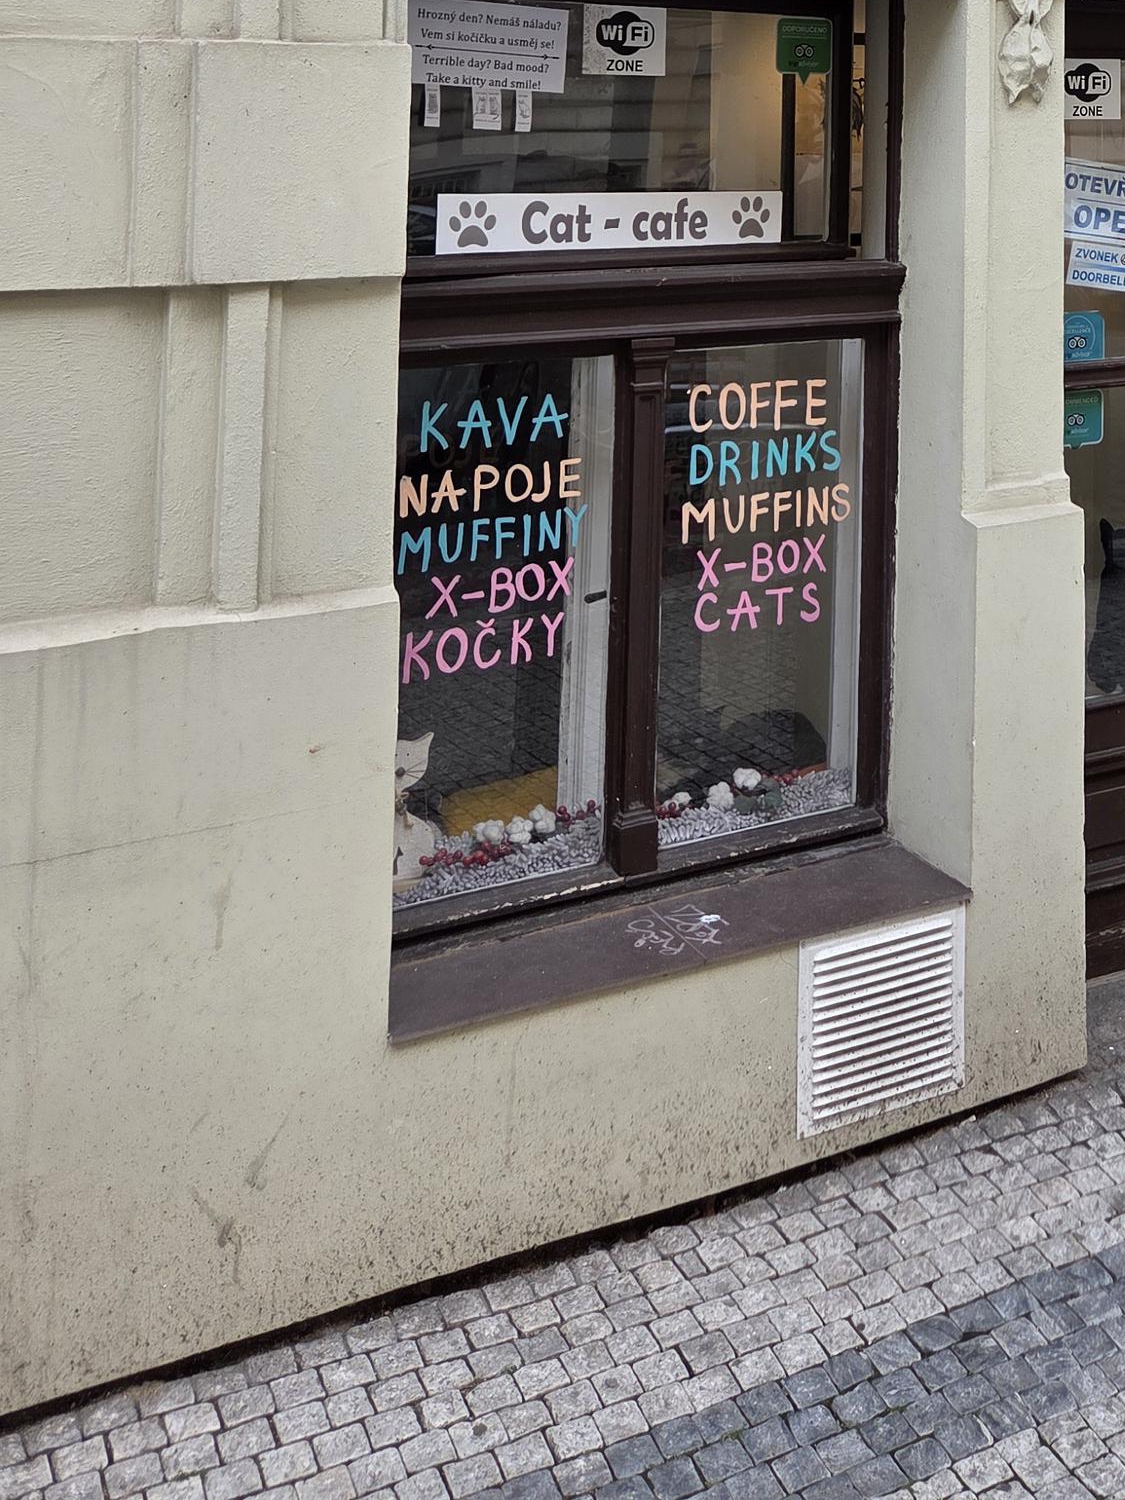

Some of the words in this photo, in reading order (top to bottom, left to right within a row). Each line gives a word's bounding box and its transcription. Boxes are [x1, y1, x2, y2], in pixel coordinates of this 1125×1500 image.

[417, 8, 457, 23] Hrozný
[459, 13, 483, 24] den?
[485, 14, 521, 27] Nemáš
[523, 20, 562, 31] náladu?
[421, 28, 444, 40] Vem
[446, 31, 455, 41] si
[507, 37, 538, 50] usměj
[540, 41, 555, 50] se!
[422, 54, 465, 67] Terrible
[467, 58, 491, 71] day?
[493, 59, 513, 71] Bad
[515, 63, 549, 74] mood?
[426, 72, 451, 84] Take
[453, 76, 459, 84] a
[461, 74, 486, 89] kitty
[488, 79, 508, 89] and
[510, 78, 541, 90] smile!
[606, 59, 643, 72] ZONE
[1072, 105, 1103, 117] ZONE
[521, 200, 592, 245] Cat
[632, 197, 709, 241] cafe
[1075, 247, 1119, 264] ZVONEK
[419, 393, 569, 453] KAVA
[688, 379, 827, 433] COFFE
[689, 429, 842, 486] DRINKS
[399, 457, 583, 519] NAPOJE
[681, 483, 851, 545] MUFFINS
[397, 503, 588, 575] MUFFINY
[696, 533, 827, 591] X-BOX
[424, 556, 575, 620] X-BOX
[694, 582, 821, 633] CATS
[402, 611, 565, 685] KOČKY
